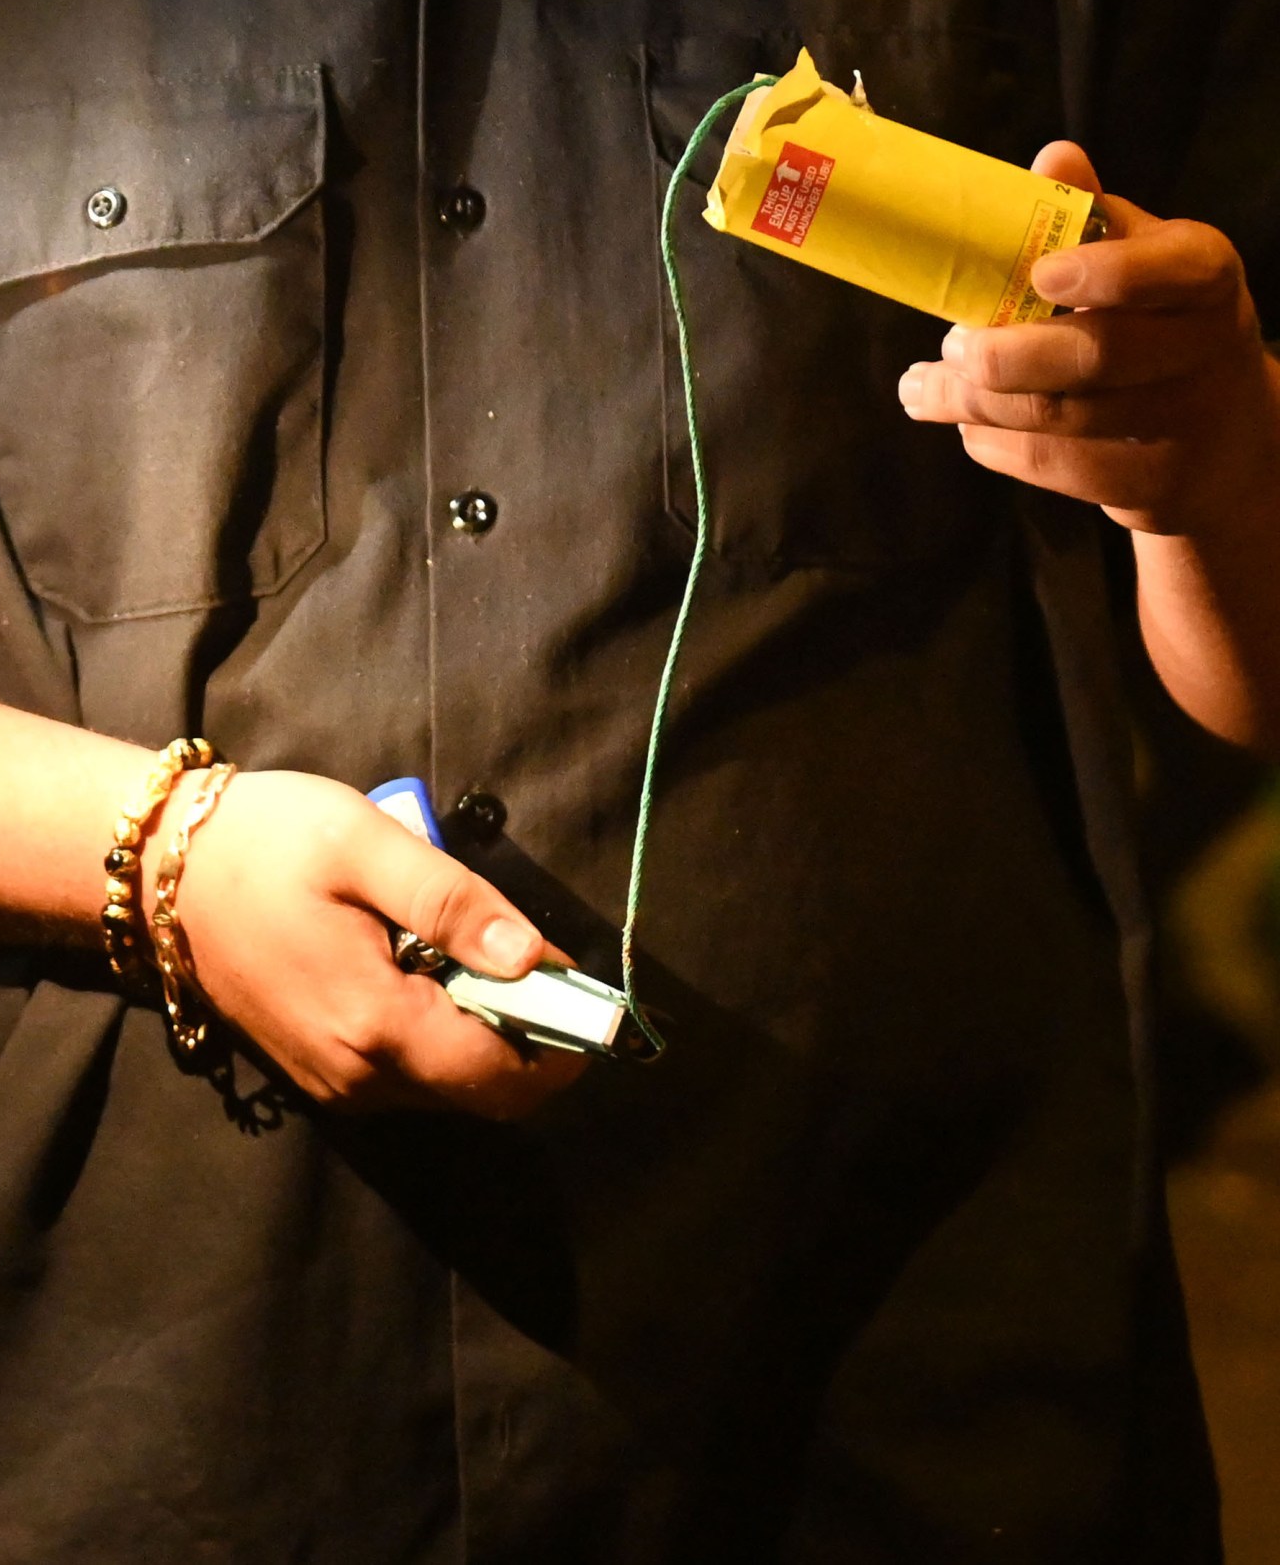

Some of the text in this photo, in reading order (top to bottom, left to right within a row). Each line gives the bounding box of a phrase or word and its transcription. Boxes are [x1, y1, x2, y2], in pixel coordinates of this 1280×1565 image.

[760, 189, 780, 214] THIS
[768, 184, 792, 227] END UP
[783, 165, 817, 232] MUST BE USED
[795, 187, 822, 237] LAUNCHER
[815, 159, 833, 186] TUBE
[1054, 182, 1071, 196] 2
